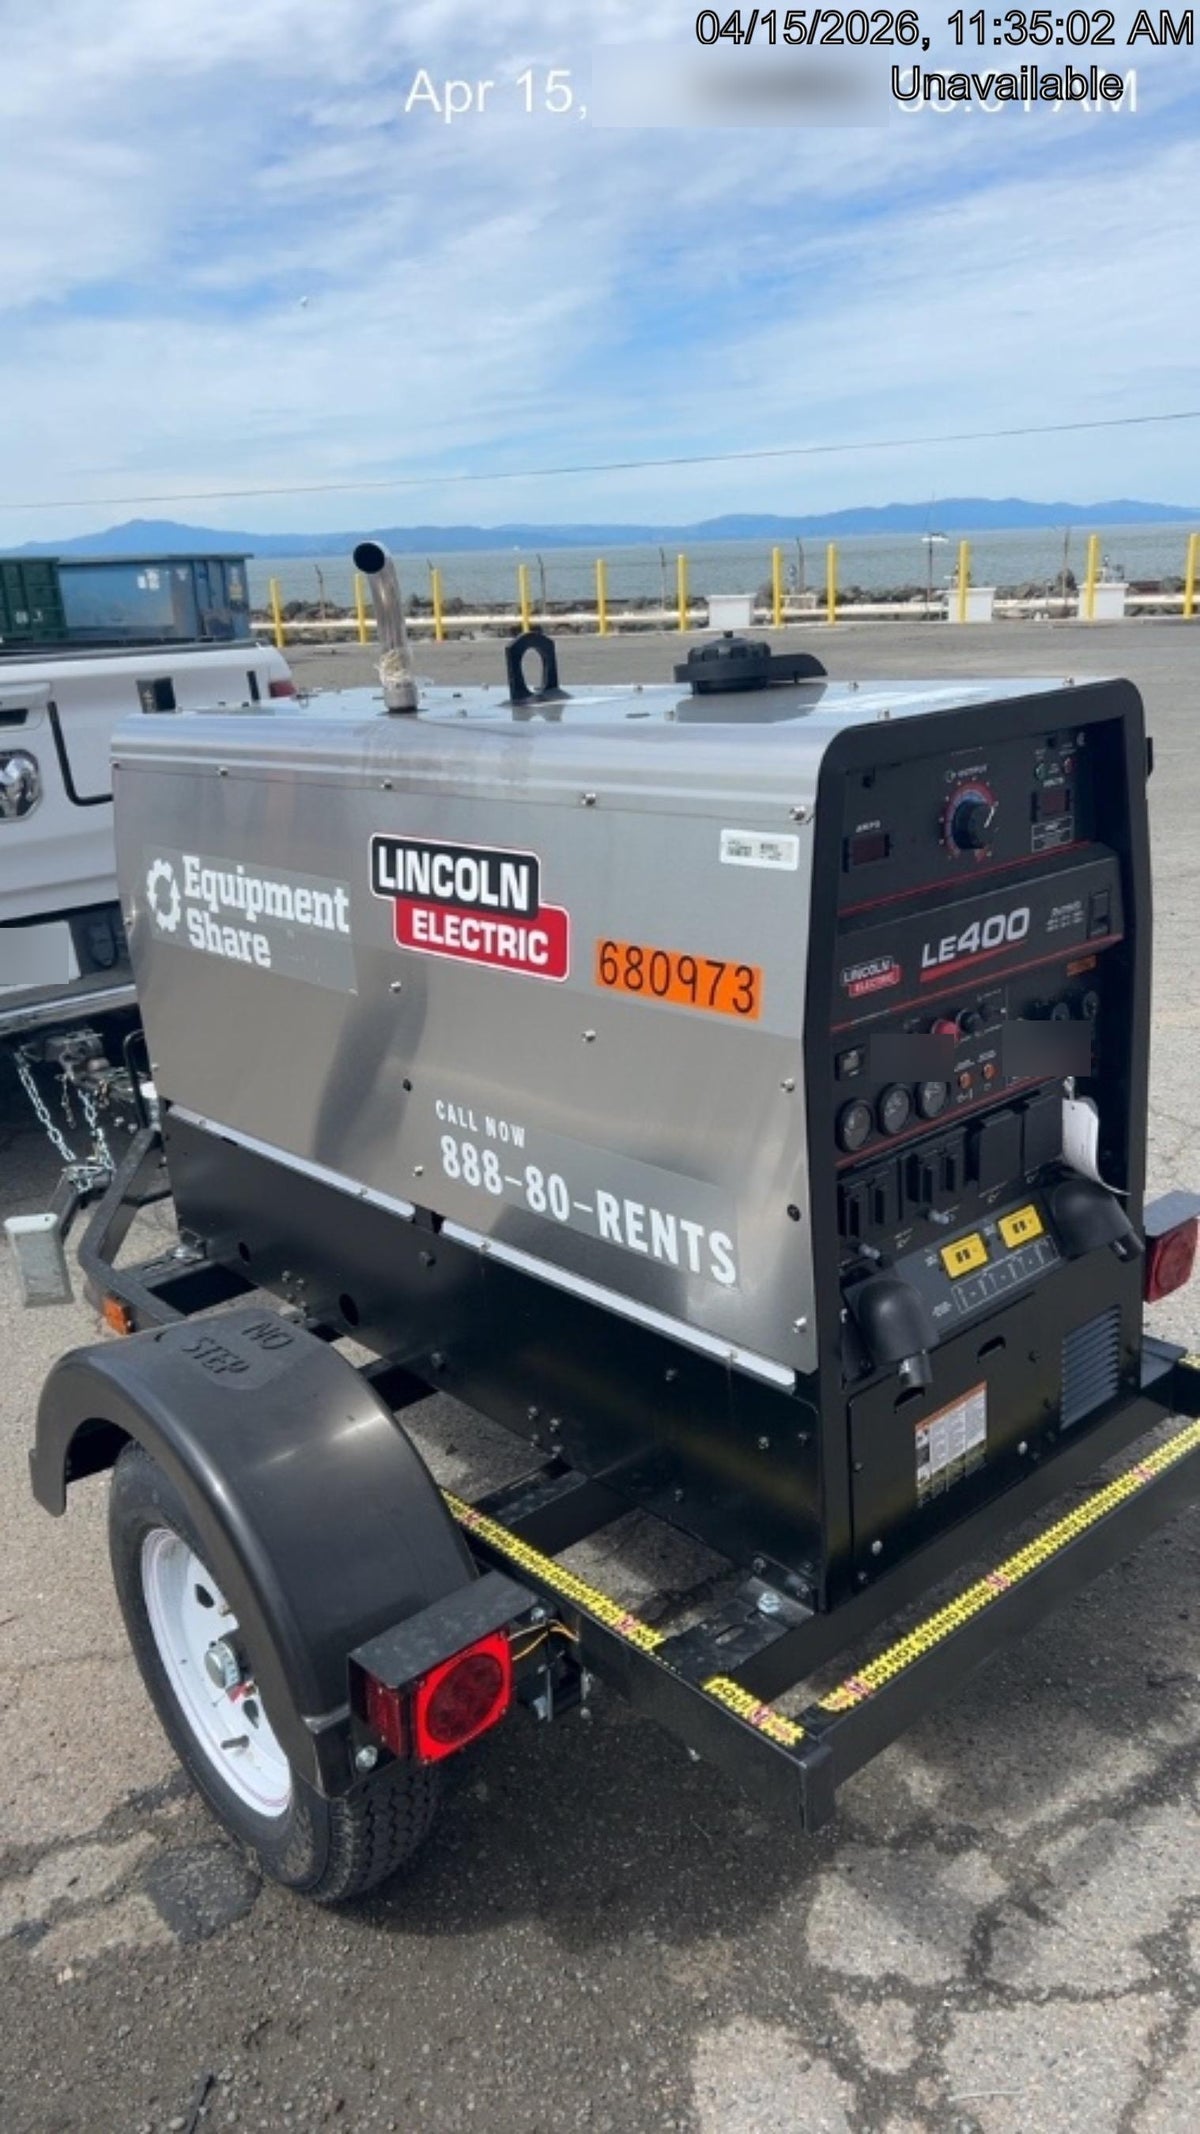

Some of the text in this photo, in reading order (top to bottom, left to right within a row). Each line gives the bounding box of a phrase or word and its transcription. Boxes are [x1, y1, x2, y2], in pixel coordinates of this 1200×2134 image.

[182, 855, 350, 933] Equipment
[378, 846, 530, 911] LINCOLN
[186, 907, 272, 969] Share
[412, 908, 549, 966] ELECTRIC
[922, 907, 1030, 968] LE400
[600, 941, 755, 1013] 680973
[843, 959, 891, 982] LINCOLN
[435, 1099, 526, 1148] CALL NOW
[440, 1134, 737, 1285] 888-80-RENTS
[181, 1336, 251, 1374] STEP
[241, 1322, 294, 1350] NO
[864, 1664, 888, 1683] DO
[886, 1643, 914, 1667] NOT
[914, 1611, 959, 1646] STAND
